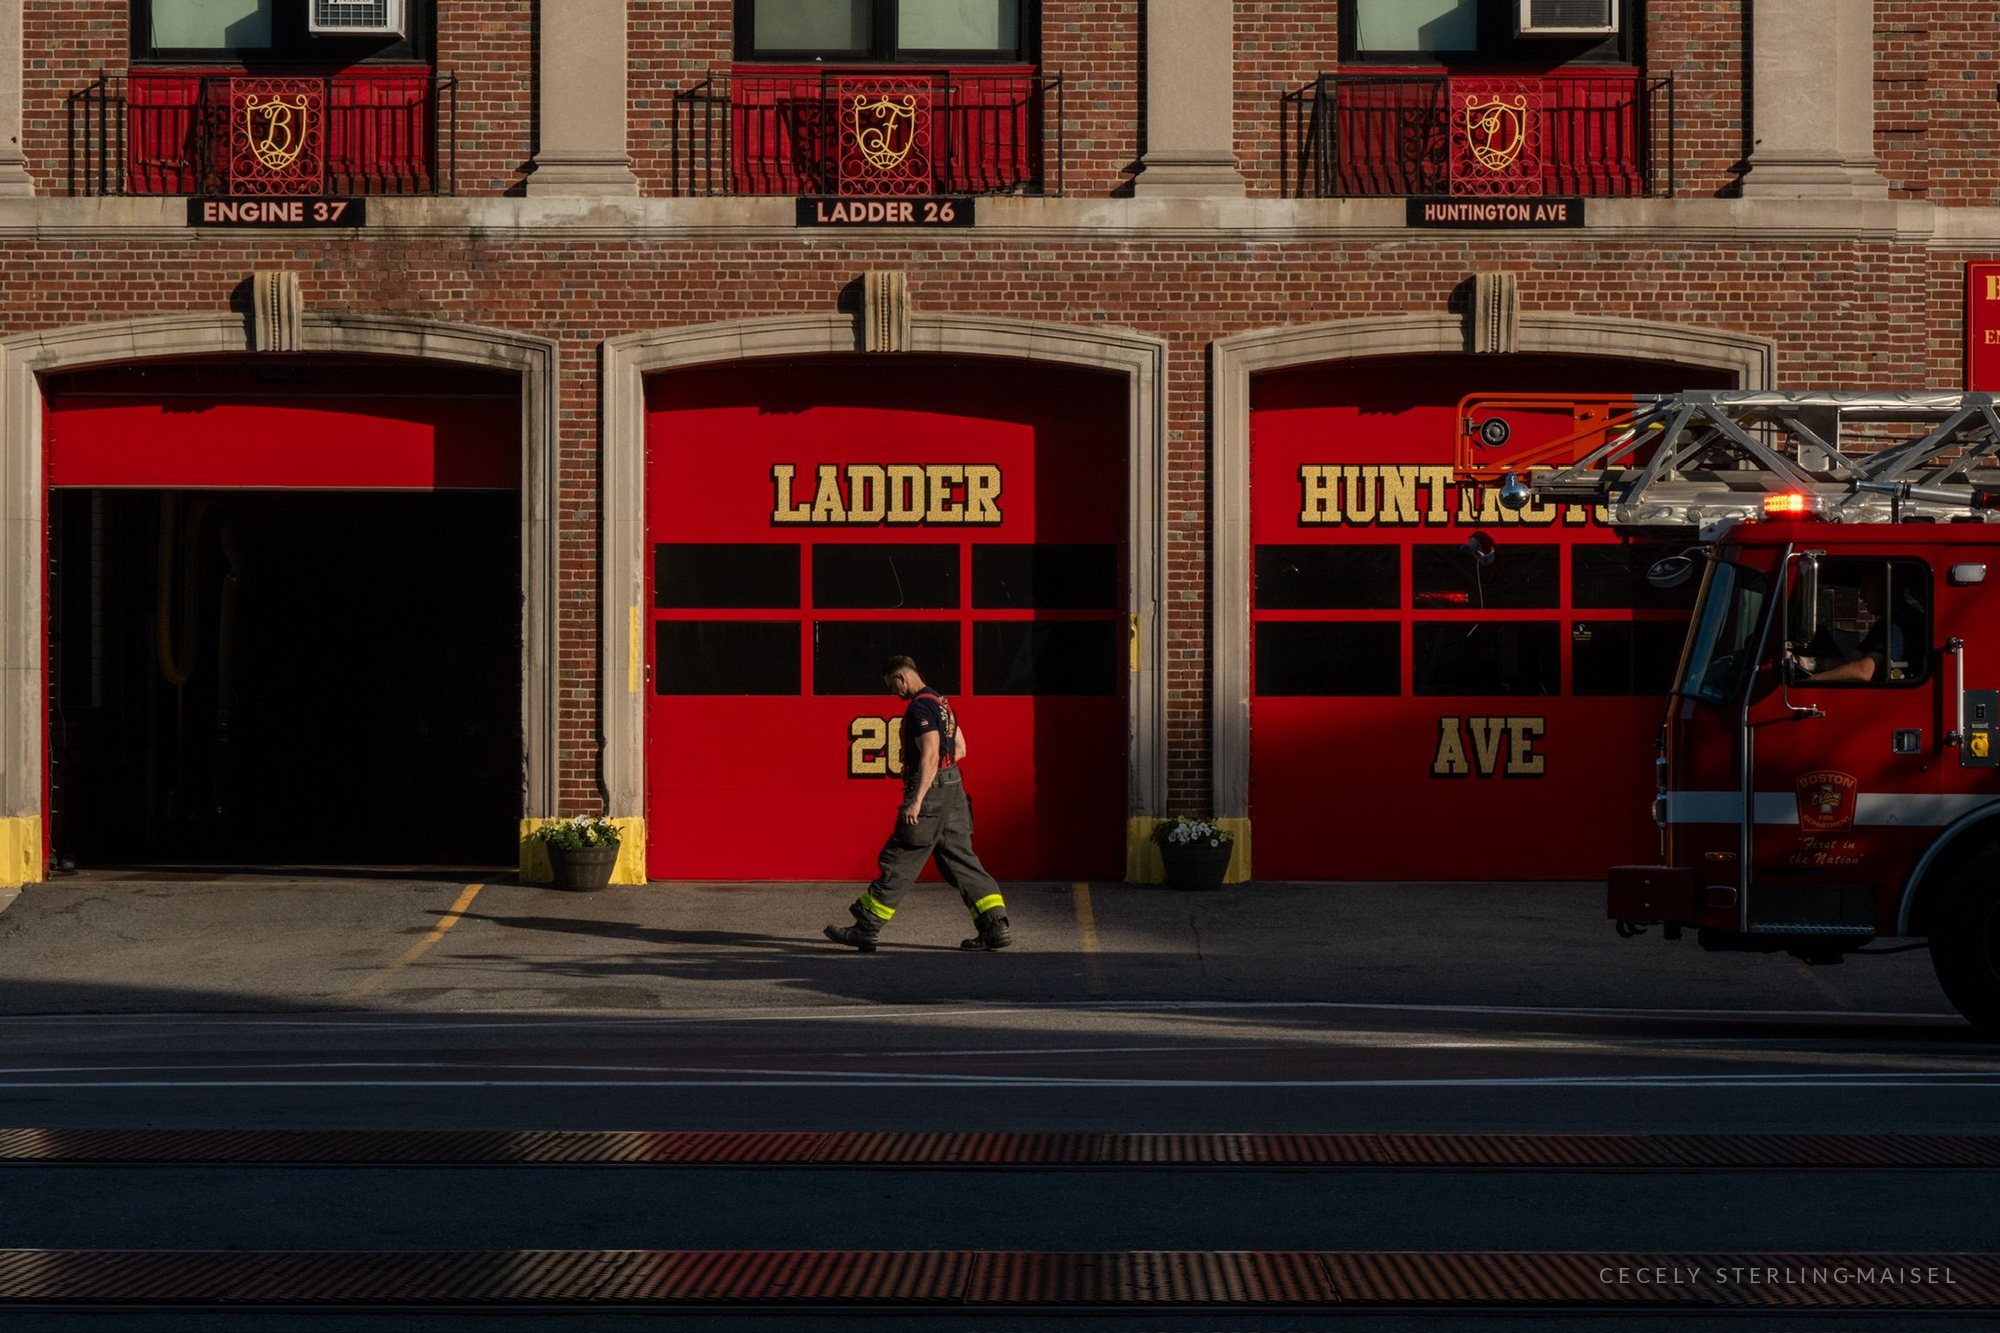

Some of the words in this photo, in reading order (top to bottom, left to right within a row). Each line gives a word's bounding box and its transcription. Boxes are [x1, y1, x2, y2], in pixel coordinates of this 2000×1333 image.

[203, 202, 303, 222] ENGINE
[313, 202, 348, 222] 37
[817, 202, 915, 222] LADDER
[924, 202, 955, 222] 26
[1425, 204, 1530, 221] HUNTINGTON
[1535, 204, 1566, 221] AVE
[773, 464, 1001, 523] LADDER
[1434, 717, 1544, 774] AVE
[1800, 773, 1855, 789] BOSTON
[1843, 840, 1856, 849] in
[1788, 852, 1809, 864] the
